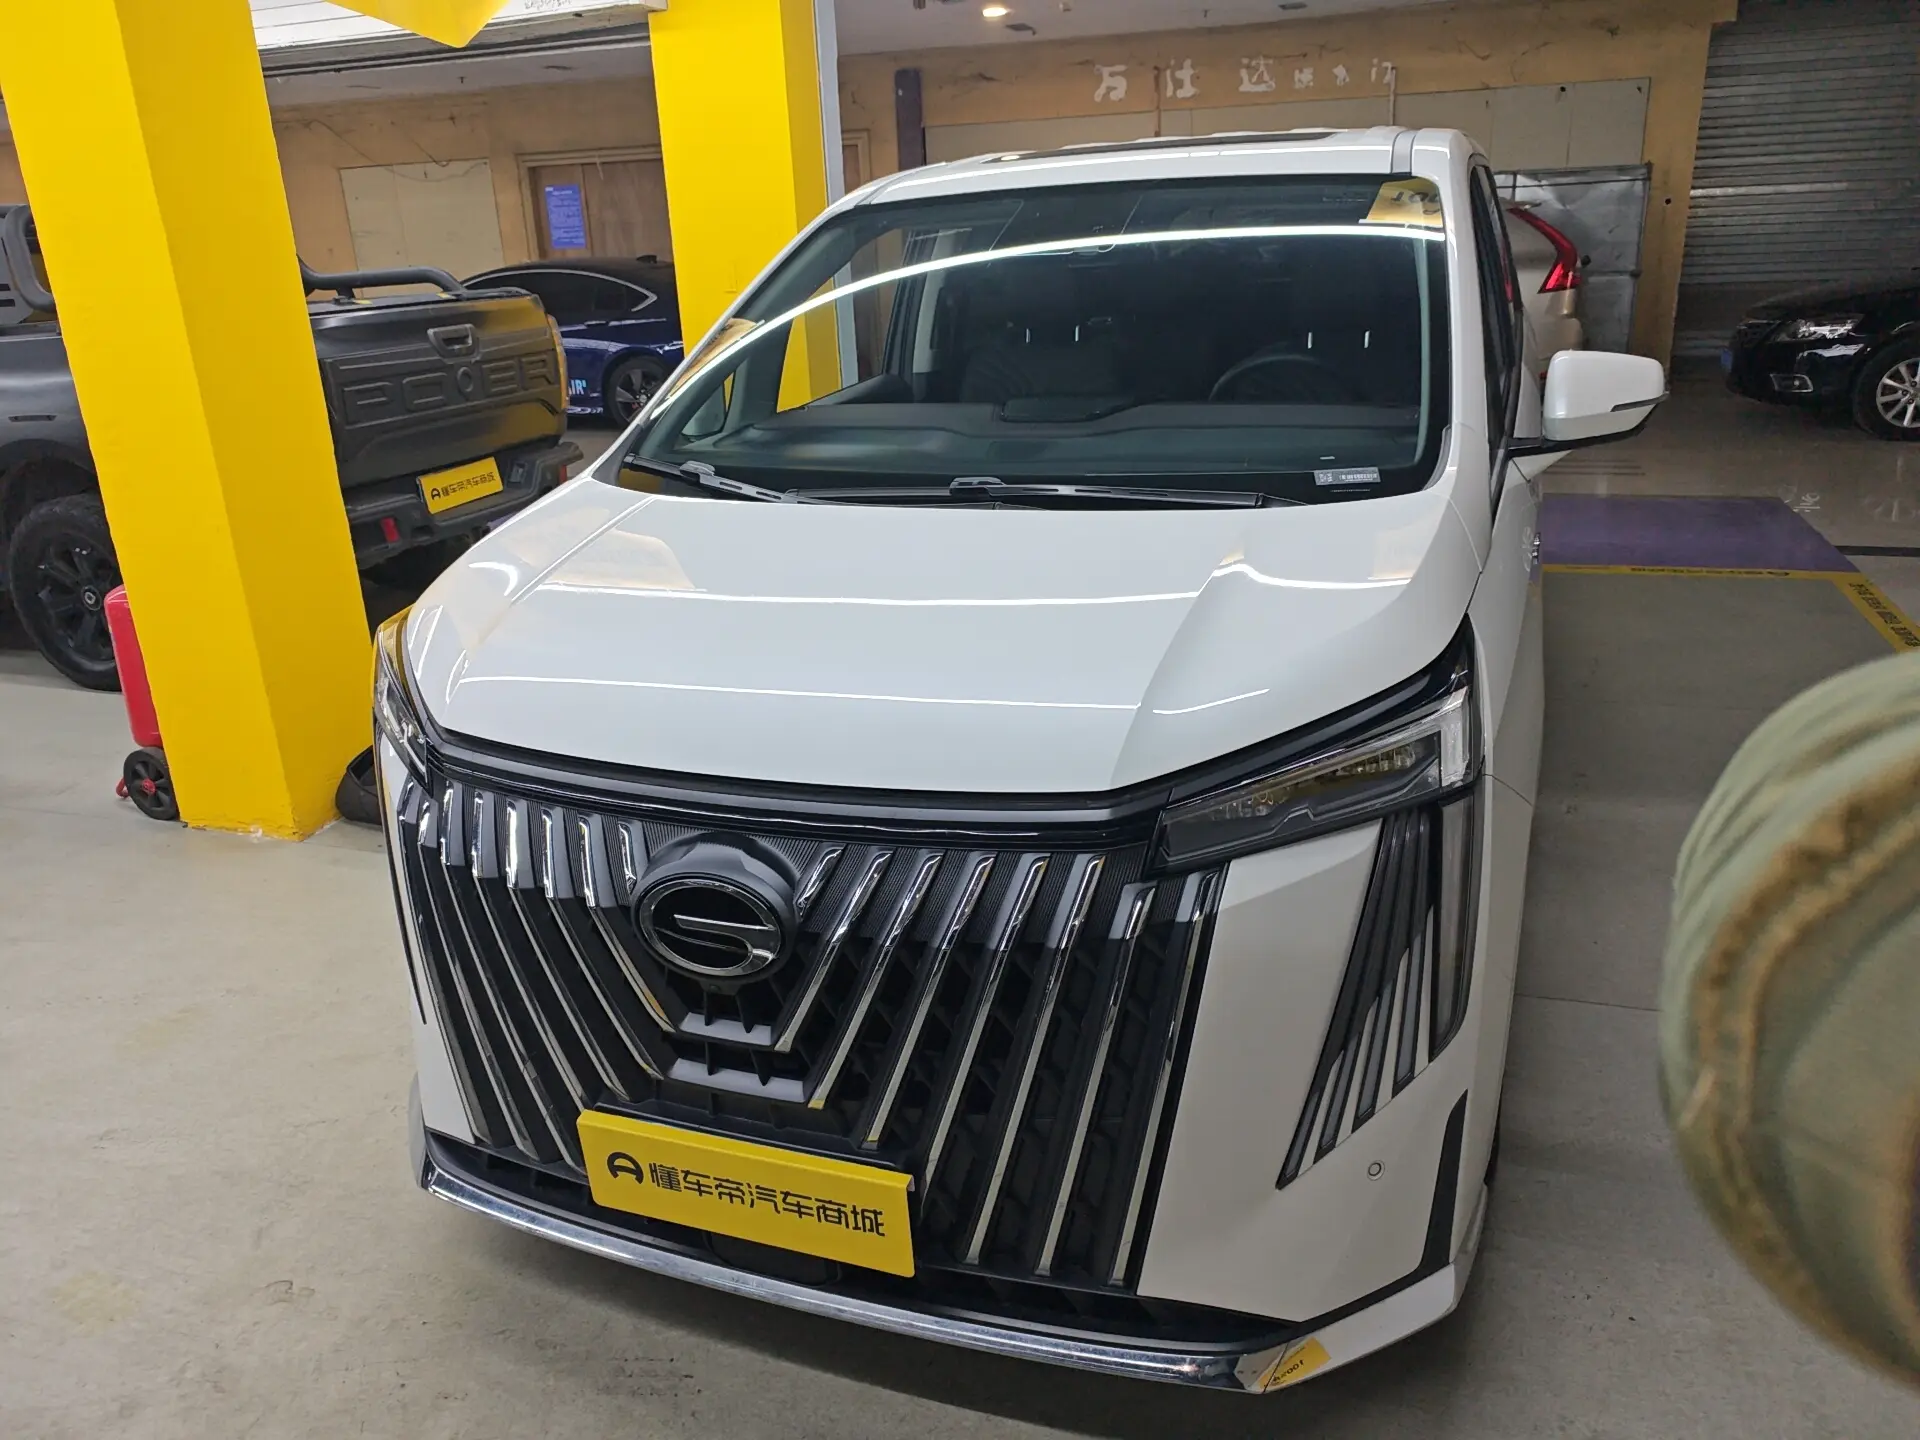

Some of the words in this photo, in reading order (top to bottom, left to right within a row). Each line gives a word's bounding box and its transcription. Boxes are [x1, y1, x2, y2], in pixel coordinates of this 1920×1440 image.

[649, 1162, 886, 1237] 懂车帝汽车商城
